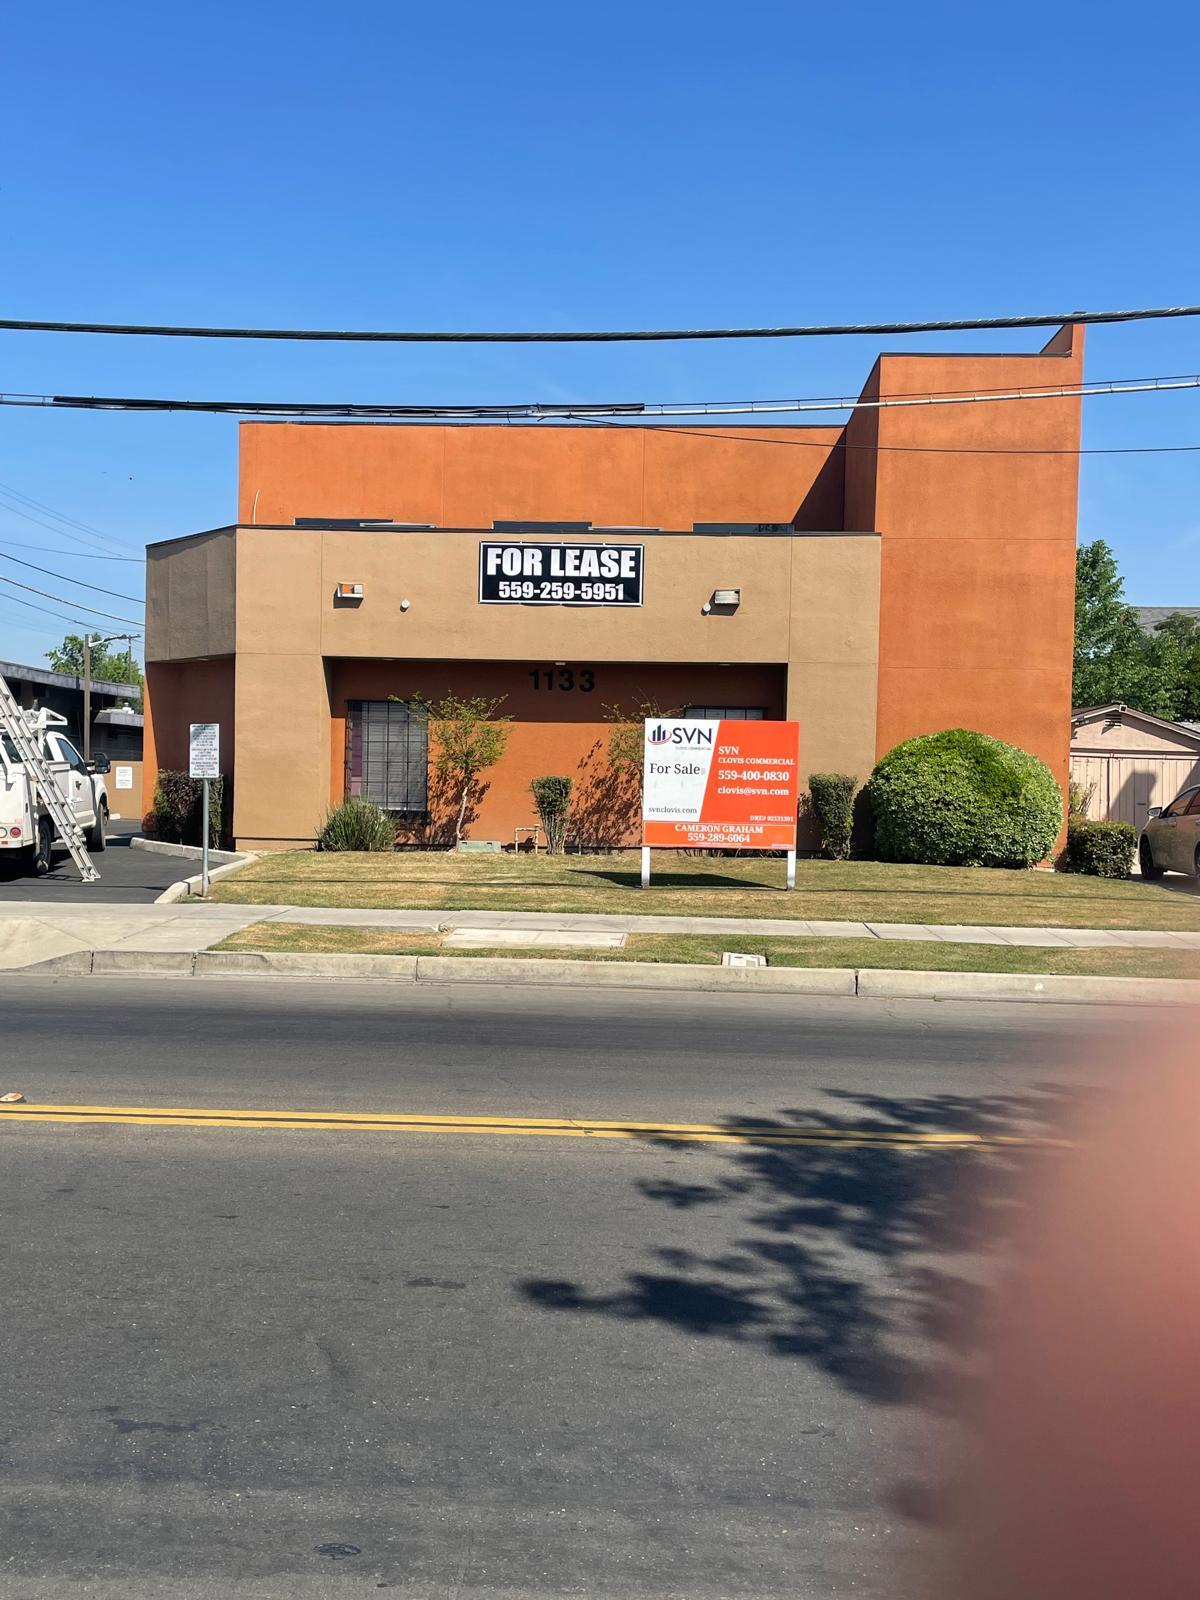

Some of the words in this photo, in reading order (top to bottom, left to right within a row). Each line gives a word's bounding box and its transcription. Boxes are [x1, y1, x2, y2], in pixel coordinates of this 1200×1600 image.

[486, 547, 543, 576] FOR
[550, 548, 636, 578] LEASE
[498, 581, 624, 600] 559-259-5951
[529, 669, 595, 692] 1133
[672, 727, 712, 744] SVN
[718, 746, 739, 755] SVN
[650, 763, 671, 774] For
[674, 763, 700, 775] Sale
[717, 770, 790, 782] 559-400-0830
[717, 787, 789, 796] clovis@svn.com
[649, 806, 697, 814] svnclovis.com
[675, 824, 720, 833] CAMERON
[722, 825, 763, 833] GRAHAM
[688, 833, 750, 843] 559-289-6064
